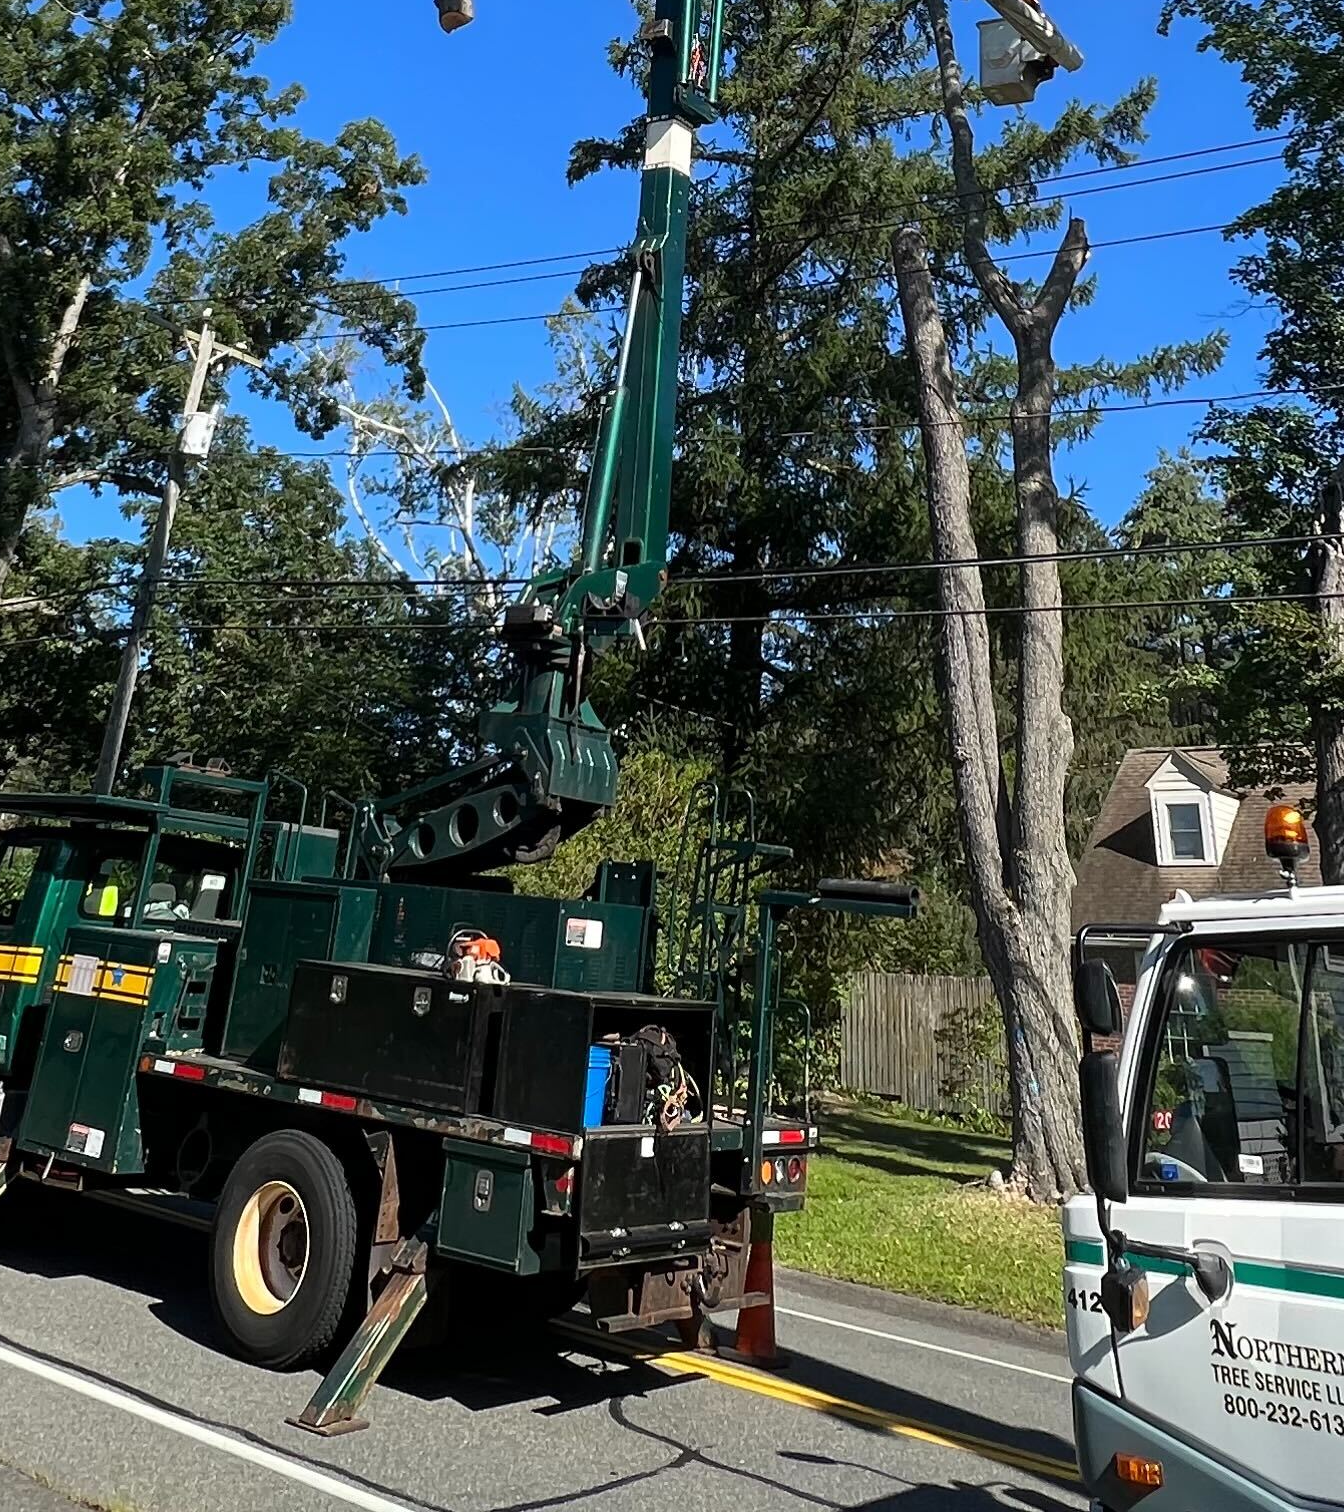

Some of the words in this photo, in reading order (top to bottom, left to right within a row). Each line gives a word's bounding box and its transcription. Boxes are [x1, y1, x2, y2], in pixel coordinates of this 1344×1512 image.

[1067, 1287, 1103, 1314] 412
[1210, 1363, 1251, 1389] TREE
[1254, 1371, 1322, 1402] SERVICE
